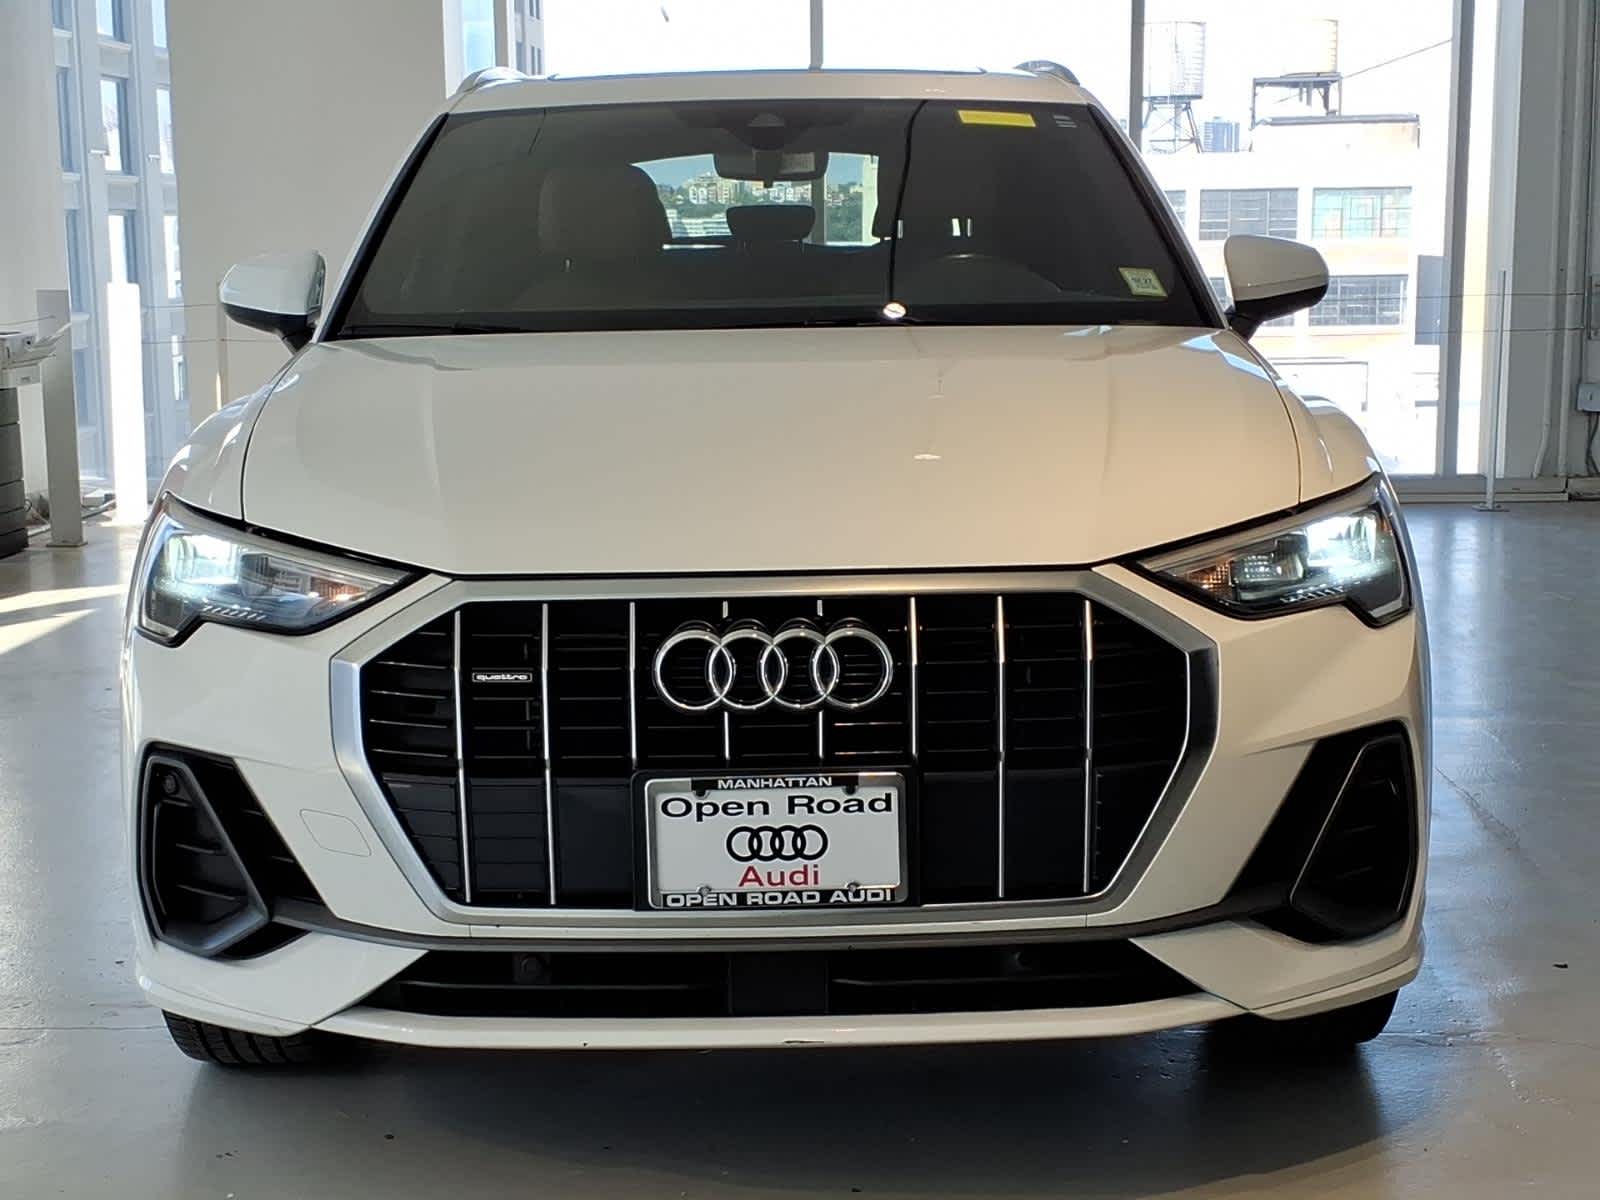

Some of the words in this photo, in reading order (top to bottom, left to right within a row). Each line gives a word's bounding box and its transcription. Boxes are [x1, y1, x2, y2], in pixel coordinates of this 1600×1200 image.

[717, 777, 833, 790] MANHATTAN
[661, 797, 770, 822] Open
[787, 793, 892, 815] Road
[738, 864, 820, 887] Audi
[666, 893, 738, 907] OPEN
[746, 890, 821, 905] ROAD
[829, 889, 892, 903] AUDI
